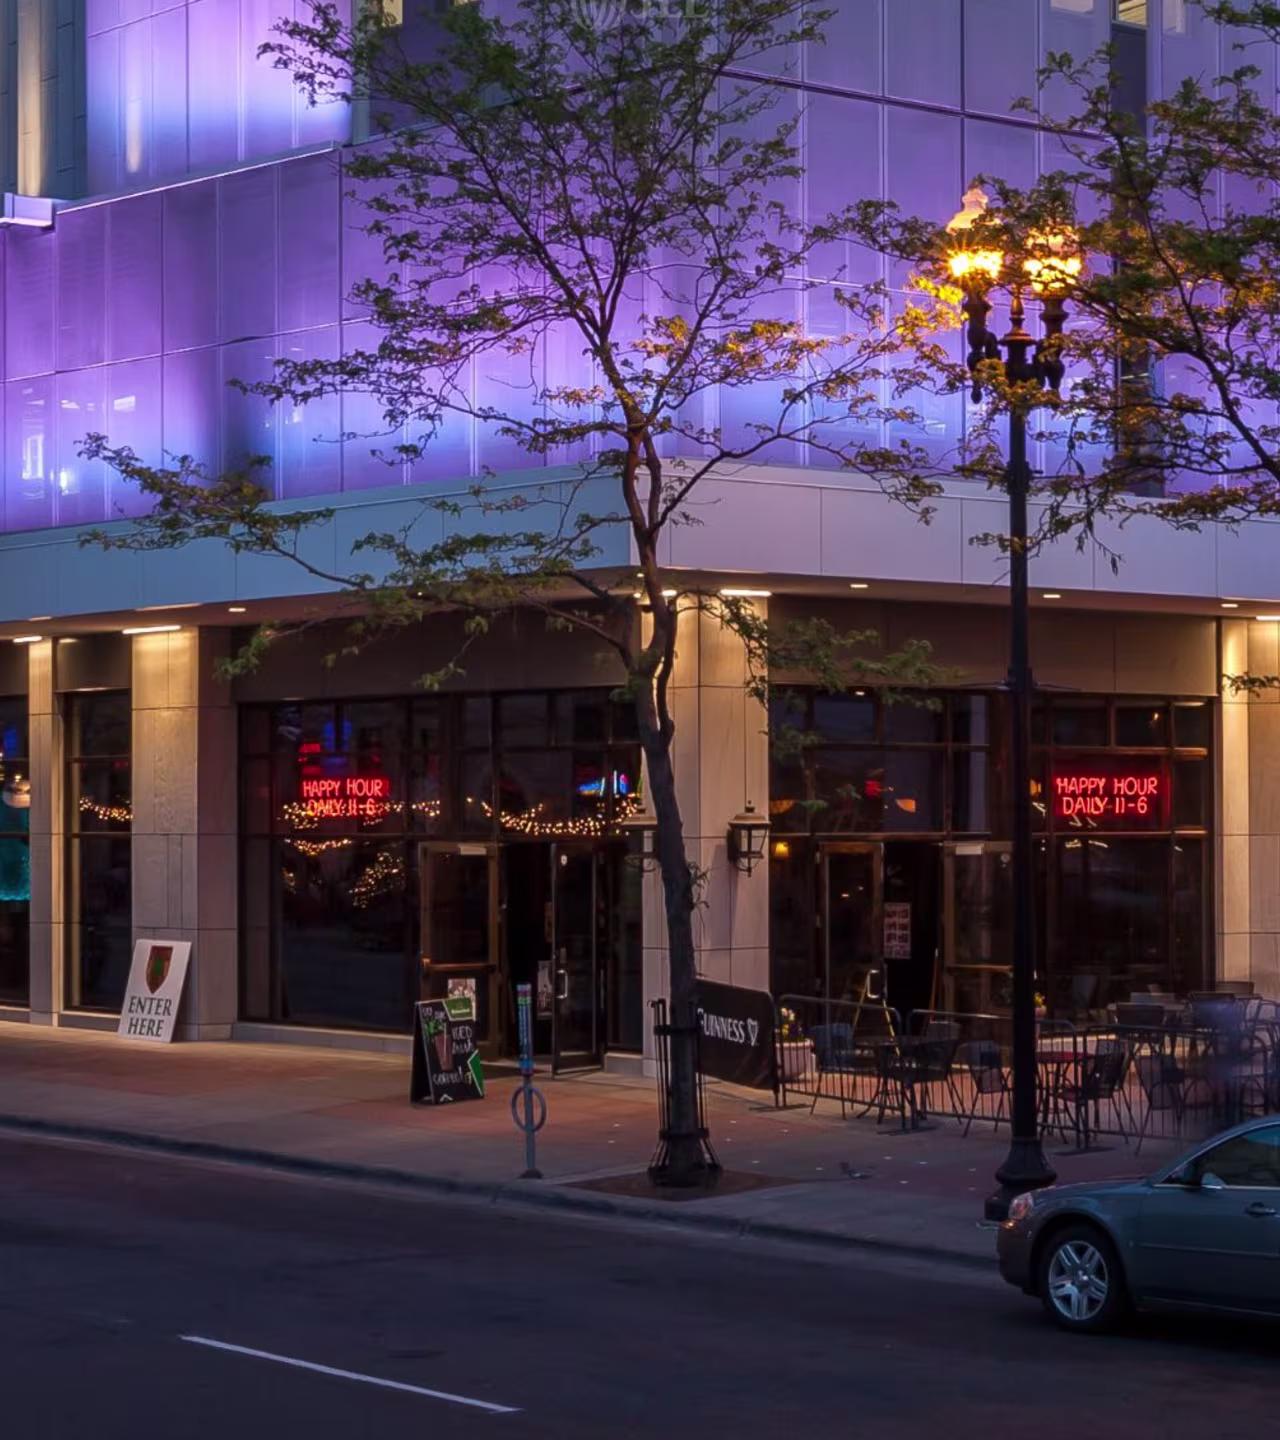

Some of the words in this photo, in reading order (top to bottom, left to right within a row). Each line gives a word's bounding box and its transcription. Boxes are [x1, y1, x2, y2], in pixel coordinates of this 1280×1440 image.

[302, 779, 341, 797] HAPPY
[346, 777, 383, 797] HOUR
[1055, 776, 1106, 796] HAPPY
[1113, 776, 1158, 796] HOUR
[306, 798, 344, 817] DAILY
[1062, 796, 1109, 816] DAILY
[1115, 796, 1148, 815] 11-6
[127, 995, 173, 1017] ENTER
[127, 1017, 165, 1038] HERE
